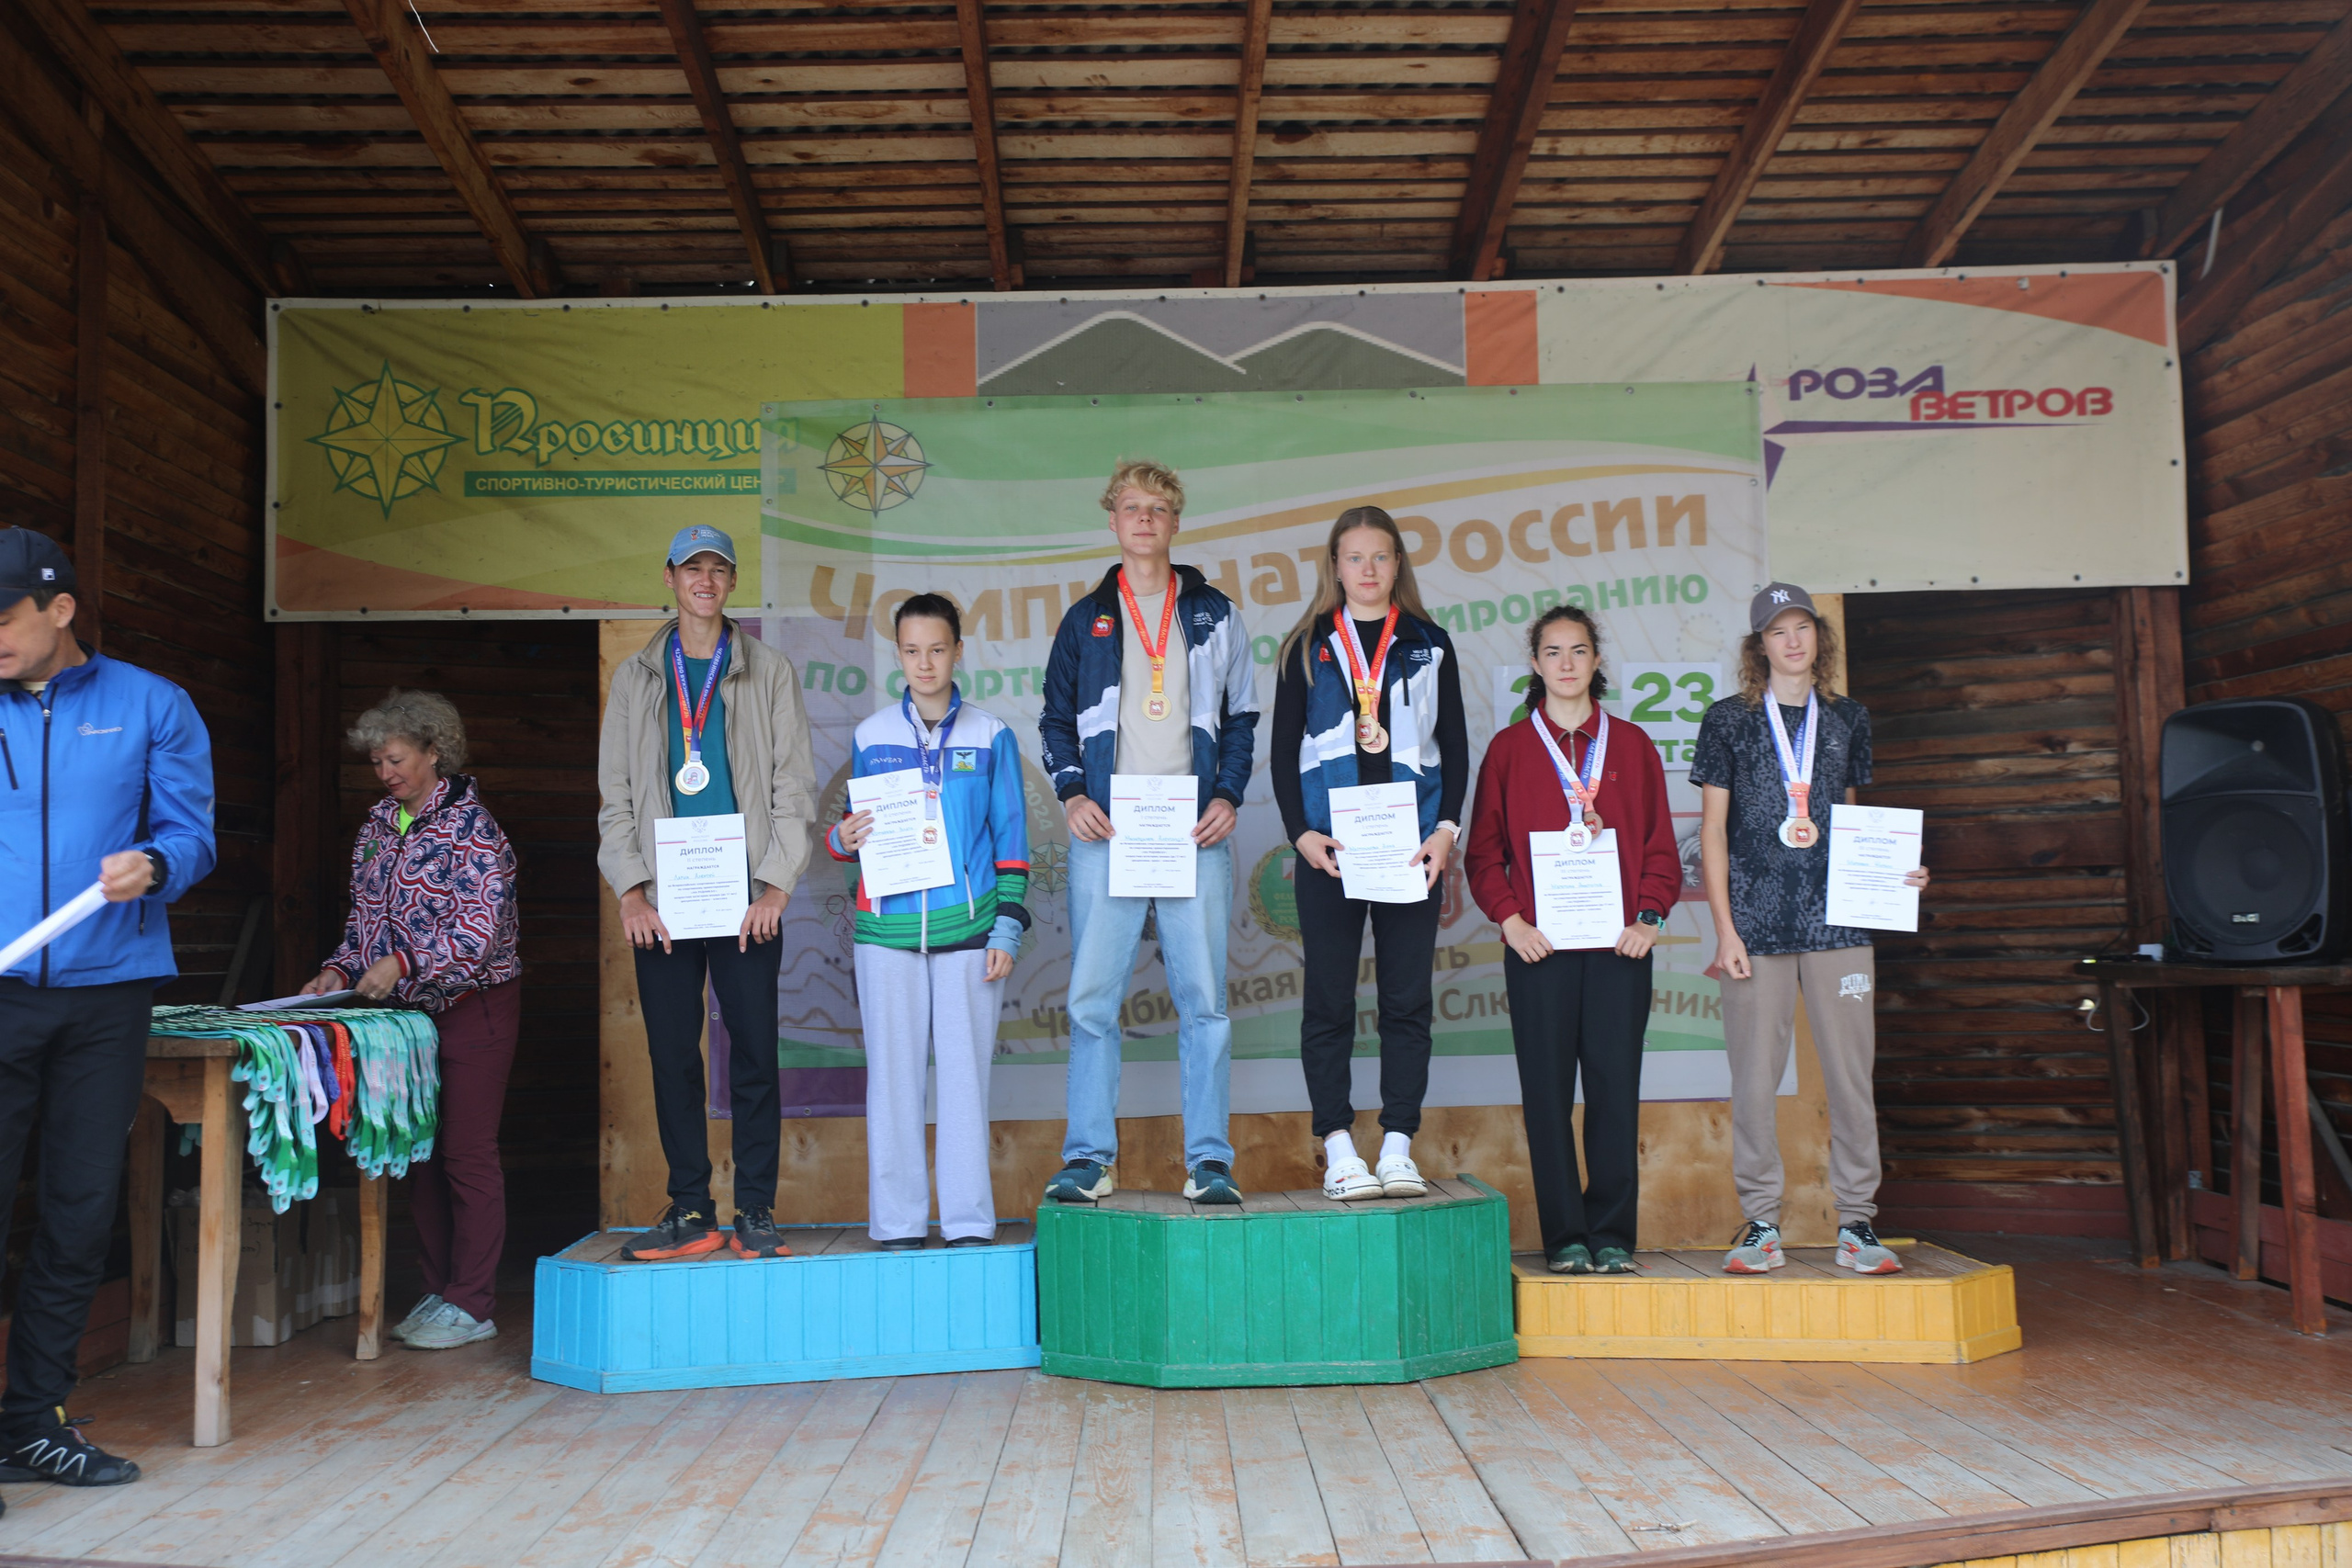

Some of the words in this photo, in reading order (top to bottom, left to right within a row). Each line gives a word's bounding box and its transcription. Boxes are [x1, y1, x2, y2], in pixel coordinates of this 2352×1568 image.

[1788, 365, 1944, 401] РОЗА
[1909, 386, 2114, 422] ВЕТРОВ
[475, 471, 727, 491] СПОРТИВНО-ТУРИСТИЧЕСКИЙ
[1159, 620, 1168, 646] ОБЛАСТЬ
[673, 648, 684, 673] ОБЛАСТЬ
[706, 647, 723, 688] ЧЕЛЯБИНСКАЯ
[803, 660, 867, 696] по
[1630, 671, 1715, 724] 23
[1582, 753, 1593, 779] ОБЛАСТЬ
[876, 798, 918, 813] ДИПЛОМ
[1133, 805, 1176, 813] ДИПЛОМ
[1354, 813, 1396, 823] ДИПЛОМ
[680, 846, 723, 856] ДИПЛОМ
[1853, 836, 1897, 845] ДИПЛОМ
[1554, 859, 1596, 867] ДИПЛОМ
